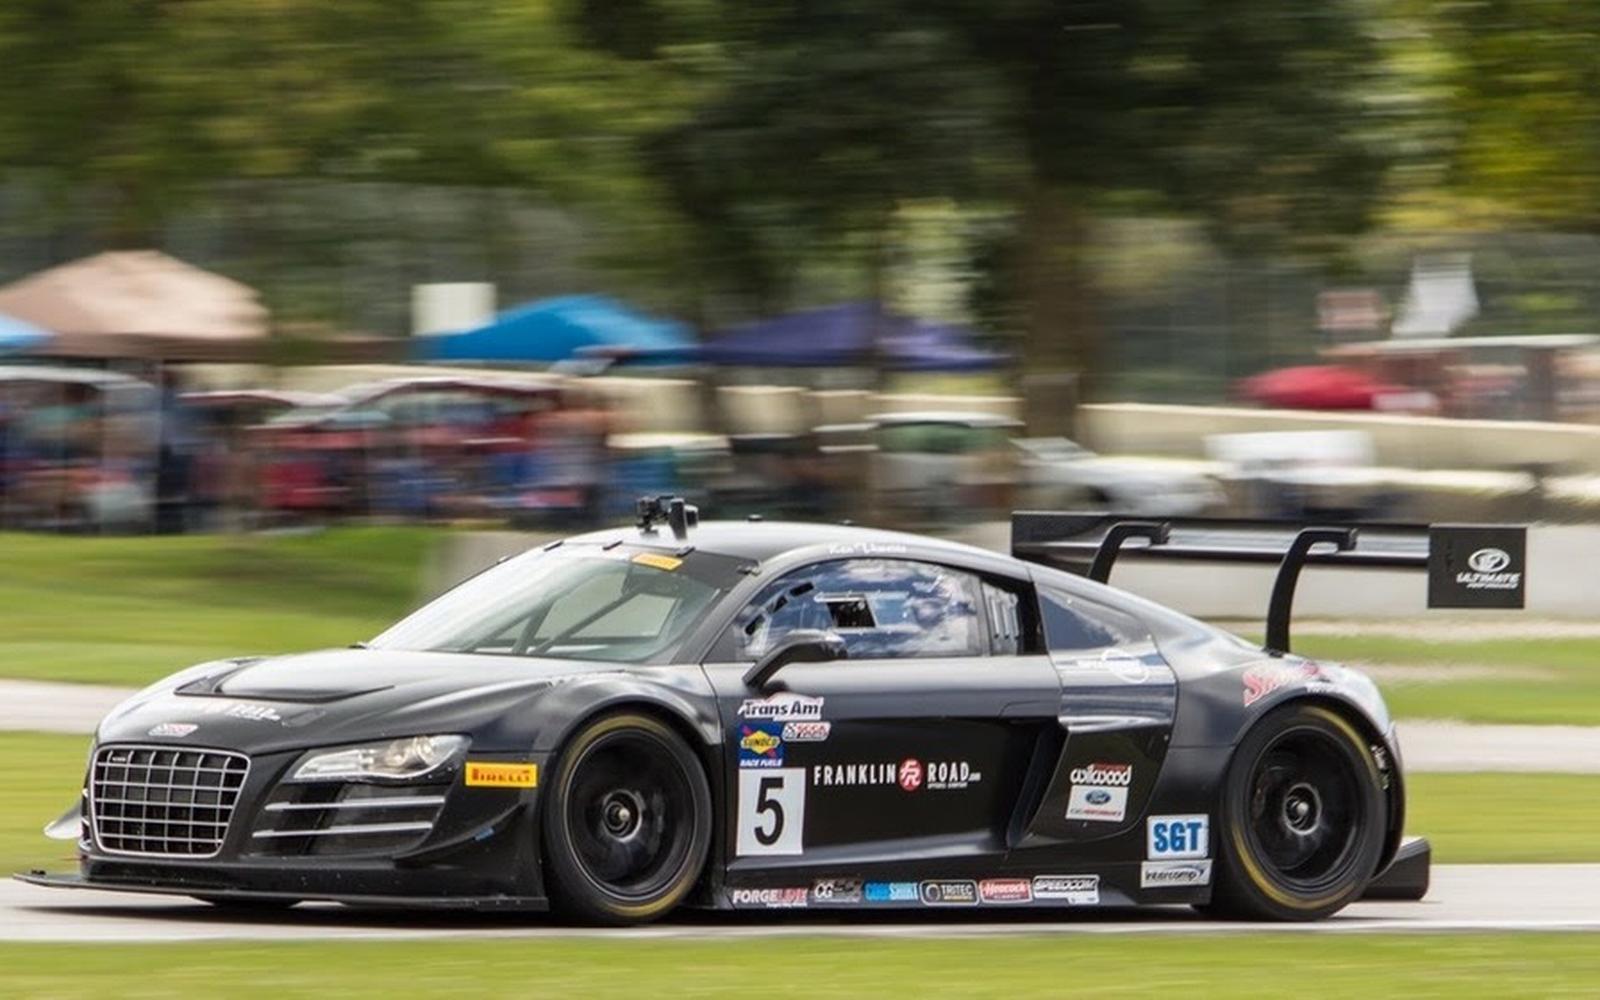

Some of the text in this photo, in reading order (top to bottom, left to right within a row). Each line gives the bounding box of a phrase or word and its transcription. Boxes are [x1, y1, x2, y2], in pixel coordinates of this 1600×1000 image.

[1456, 572, 1520, 583] ULTIMATE
[744, 700, 819, 715] Trans Am
[472, 768, 531, 783] PIRELLI
[813, 763, 897, 786] FRANKLIN
[927, 761, 969, 782] ROAD
[754, 776, 785, 847] 5
[1153, 821, 1203, 853] SGT
[941, 884, 973, 896] TRITEC
